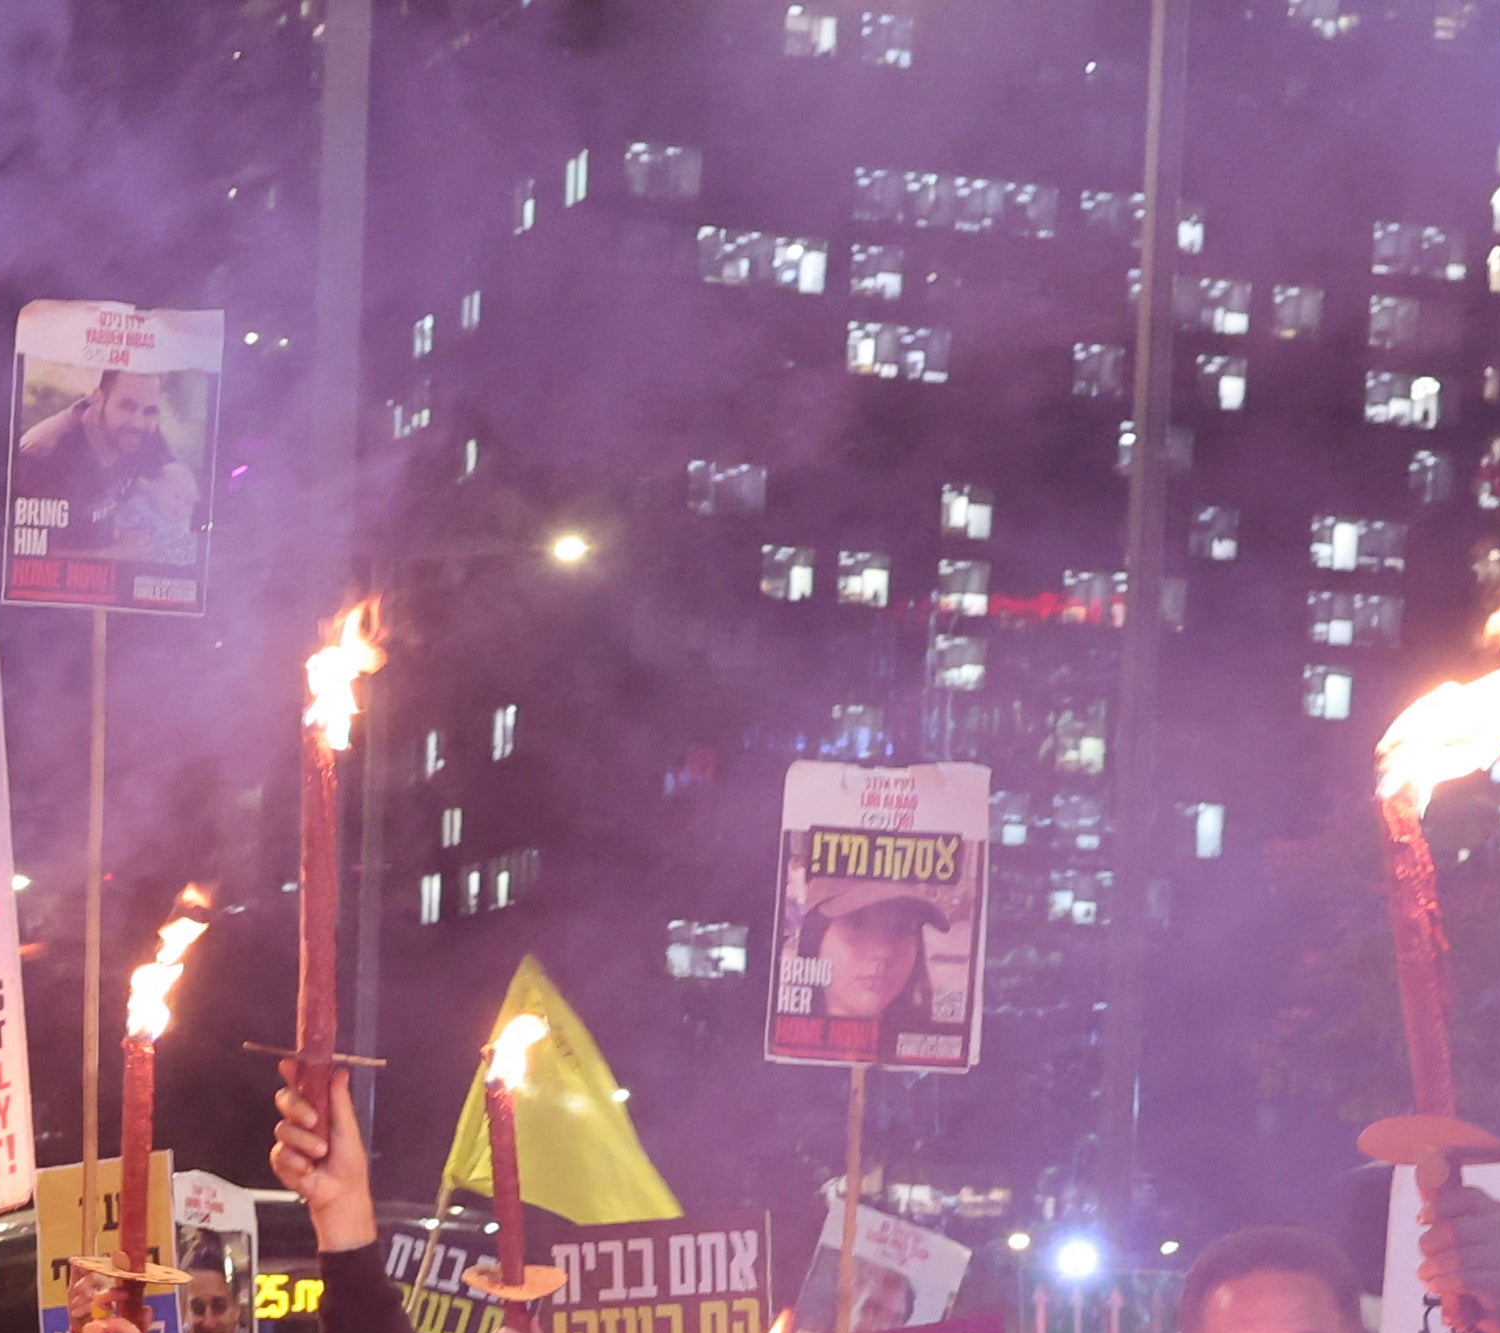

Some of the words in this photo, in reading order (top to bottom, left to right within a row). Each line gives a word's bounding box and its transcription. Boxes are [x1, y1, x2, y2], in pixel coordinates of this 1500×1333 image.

[14, 497, 70, 528] BRING
[13, 527, 49, 556] HIM
[811, 832, 870, 875] מיד!
[781, 956, 833, 987] BRING
[777, 985, 813, 1015] HER
[551, 1237, 659, 1305] בבית
[668, 1230, 759, 1296] אתם
